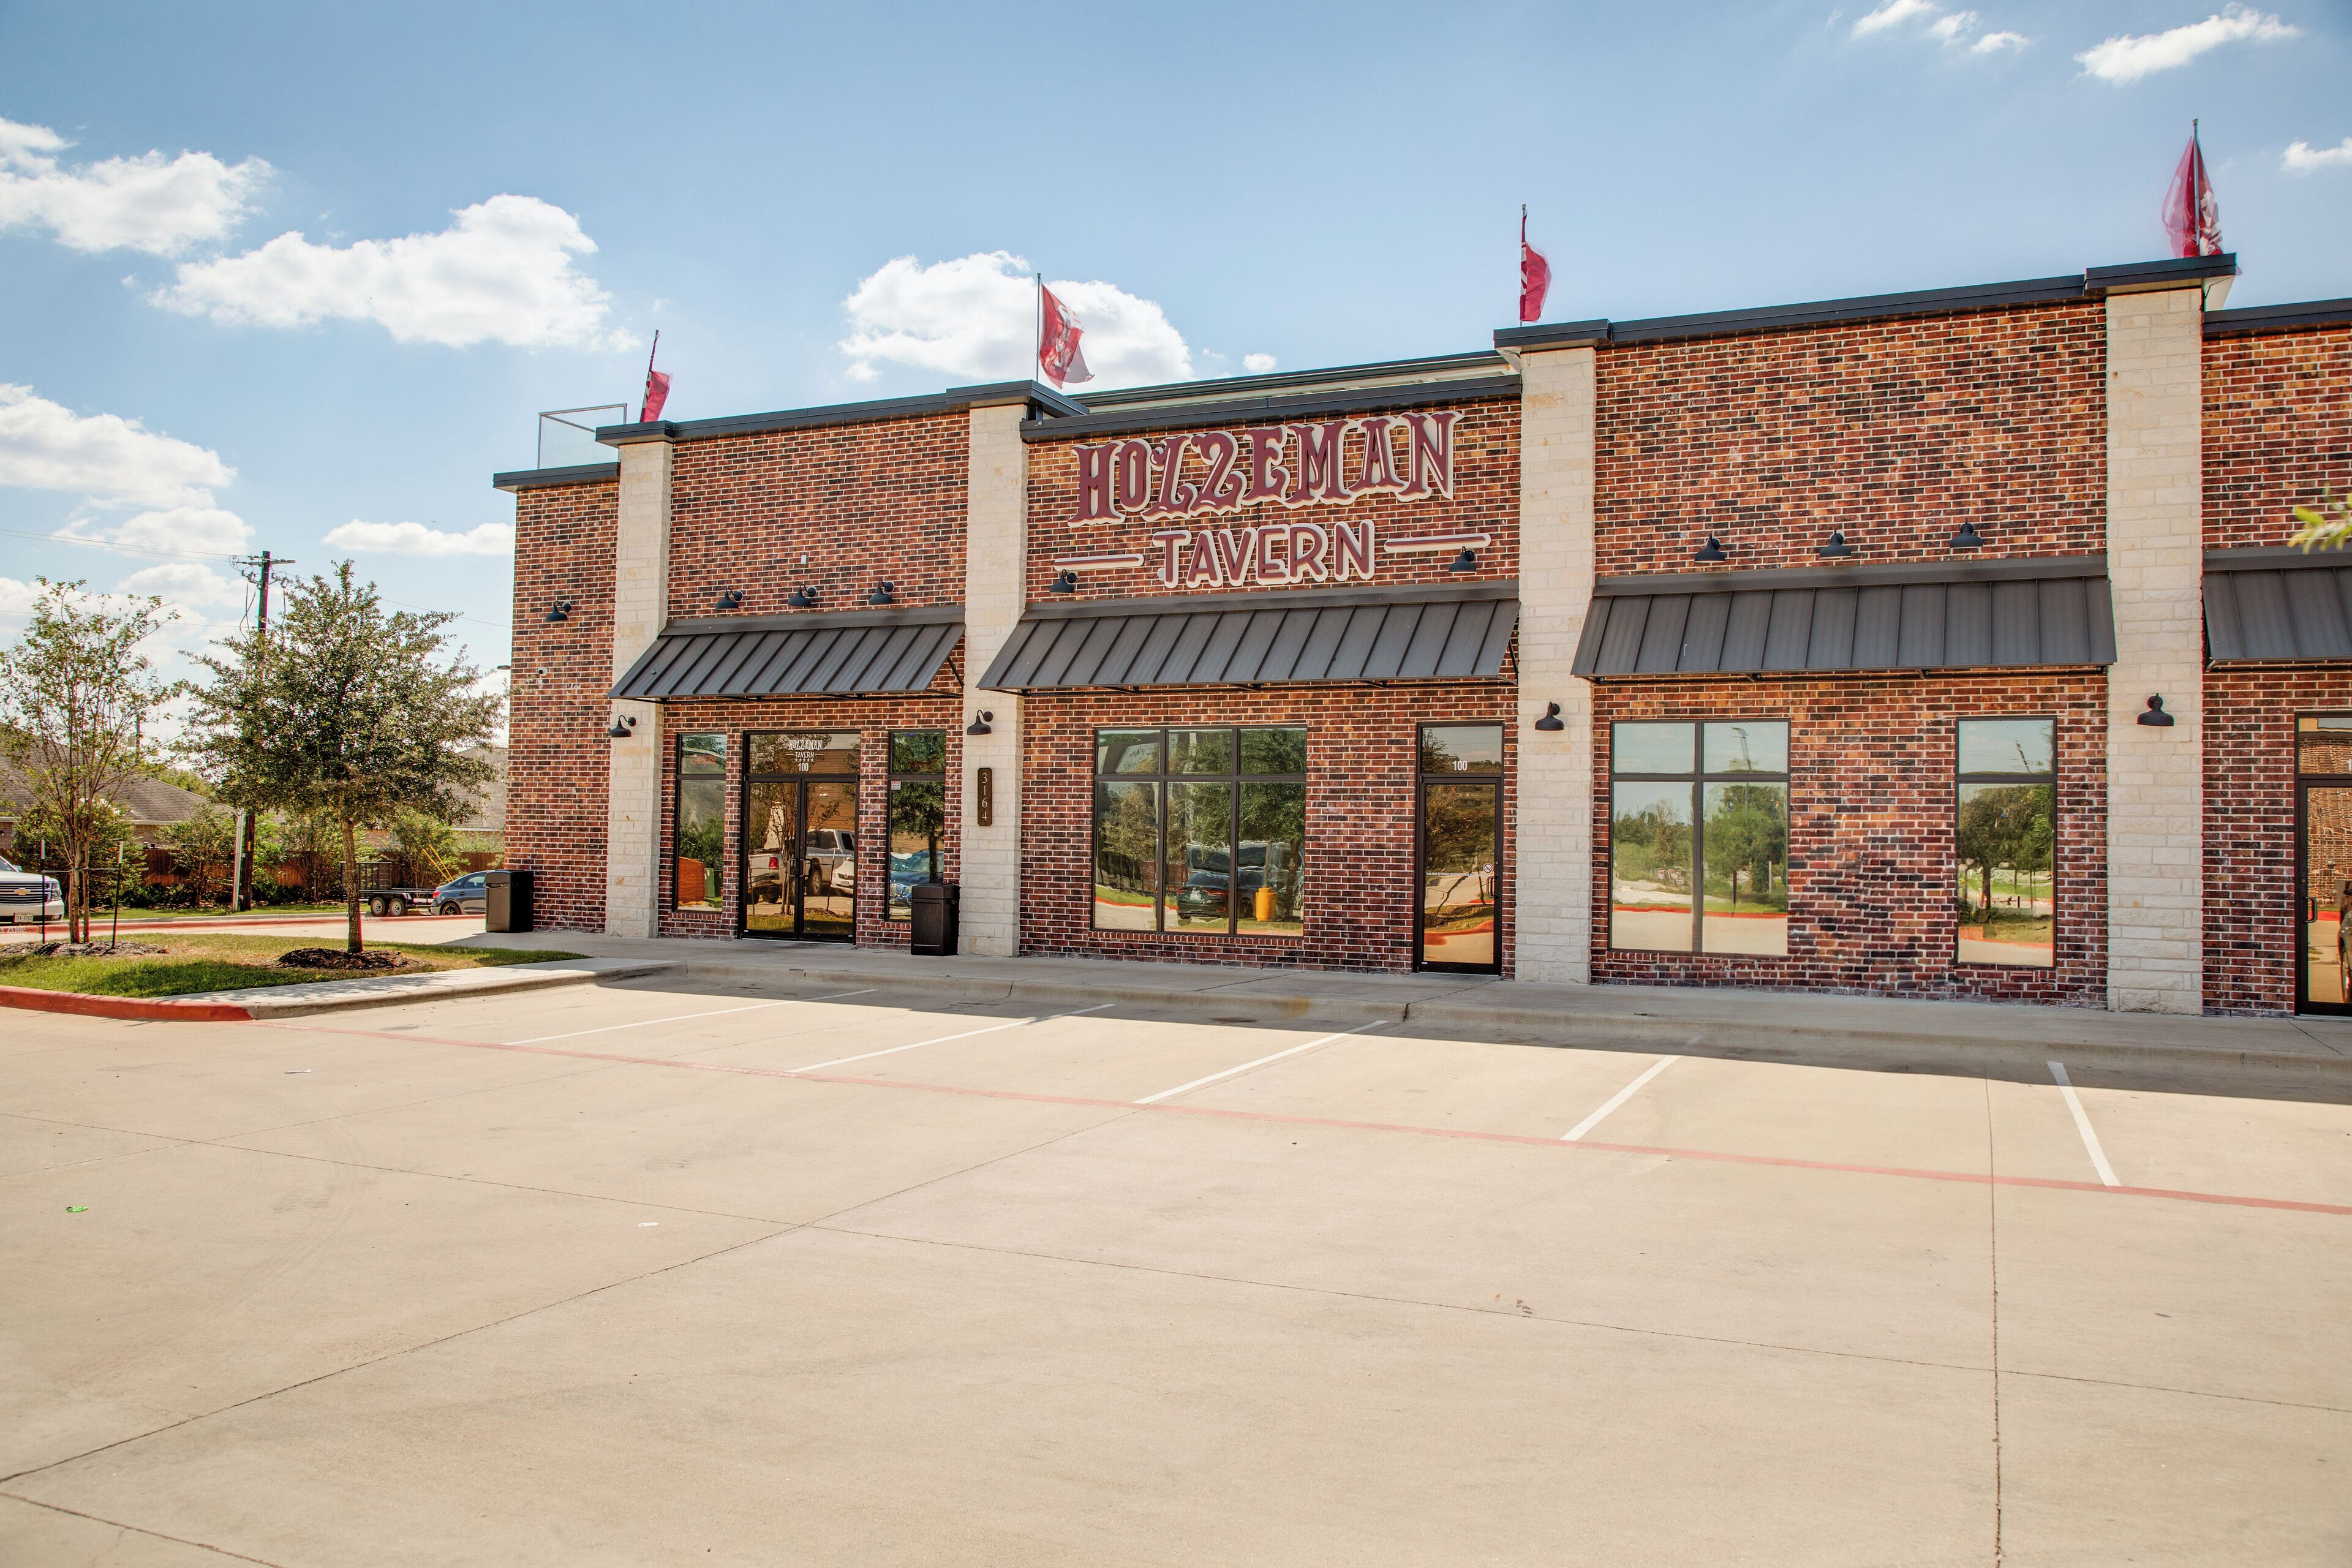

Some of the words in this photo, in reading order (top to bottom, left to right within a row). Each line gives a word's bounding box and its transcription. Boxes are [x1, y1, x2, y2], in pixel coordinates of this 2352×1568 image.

[1153, 519, 1374, 588] TAVERN
[798, 763, 809, 772] 100
[1452, 760, 1468, 771] 100
